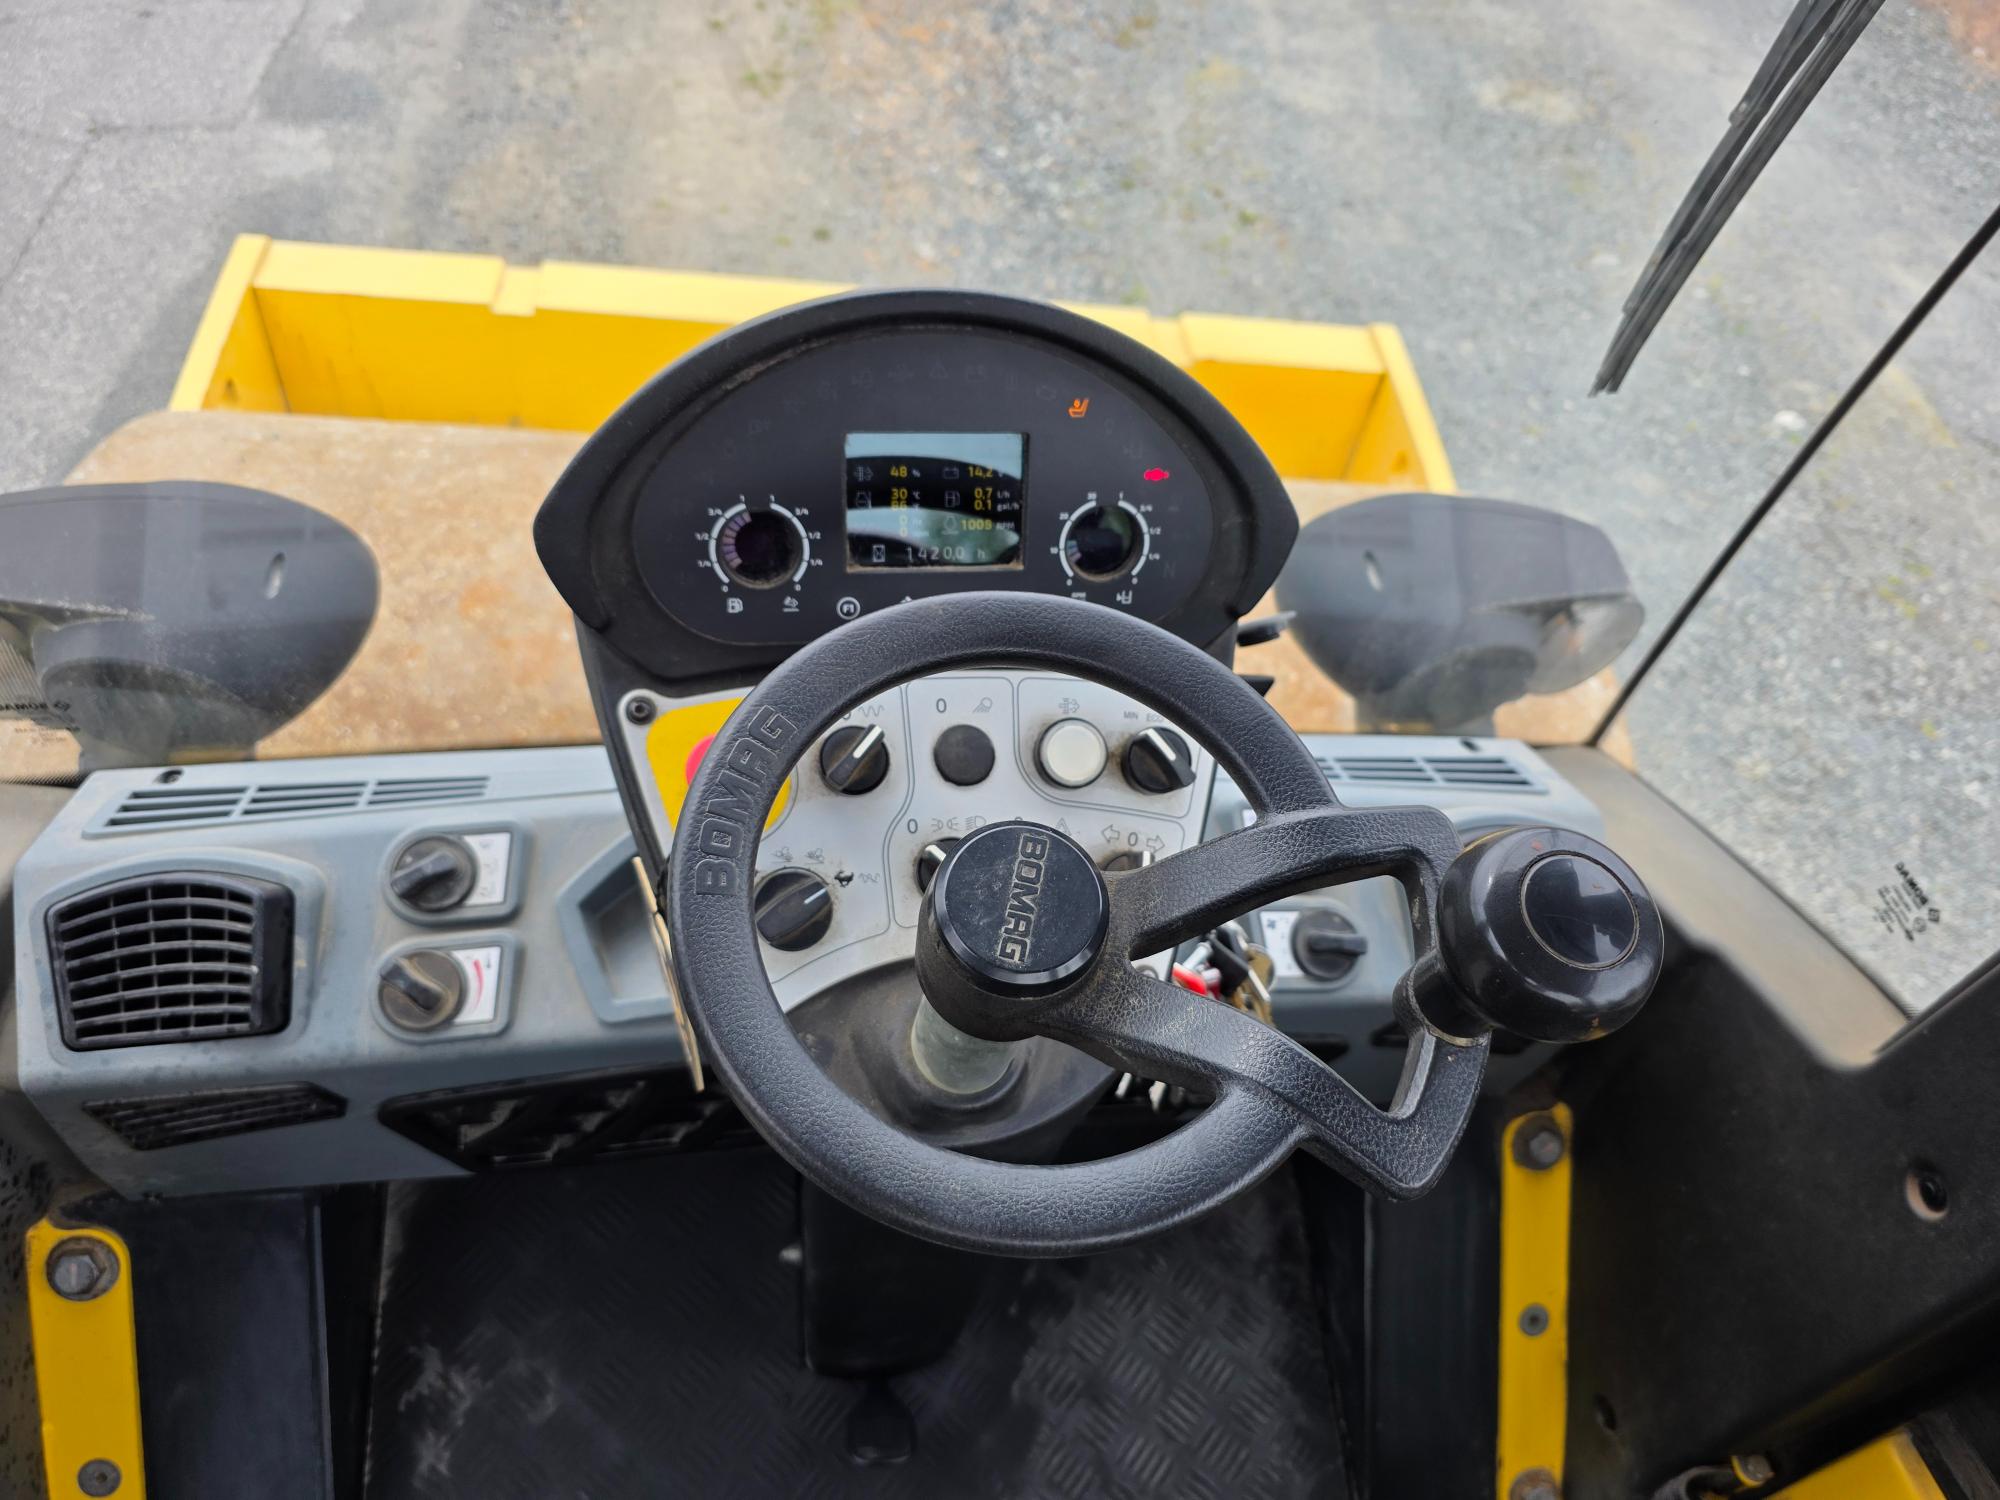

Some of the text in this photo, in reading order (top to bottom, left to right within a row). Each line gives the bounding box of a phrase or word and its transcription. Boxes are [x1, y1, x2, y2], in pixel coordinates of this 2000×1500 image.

[890, 466, 908, 478] 48
[891, 488, 908, 500] 30
[695, 532, 709, 541] 1/2
[808, 531, 822, 540] 1/2
[810, 559, 823, 567] 1/4
[721, 584, 729, 593] 0
[794, 584, 801, 592] 0
[936, 698, 947, 714] 0
[694, 704, 799, 896] BOMAG
[907, 818, 918, 834] 0
[1127, 831, 1138, 847] 0
[998, 832, 1050, 964] BOMAG
